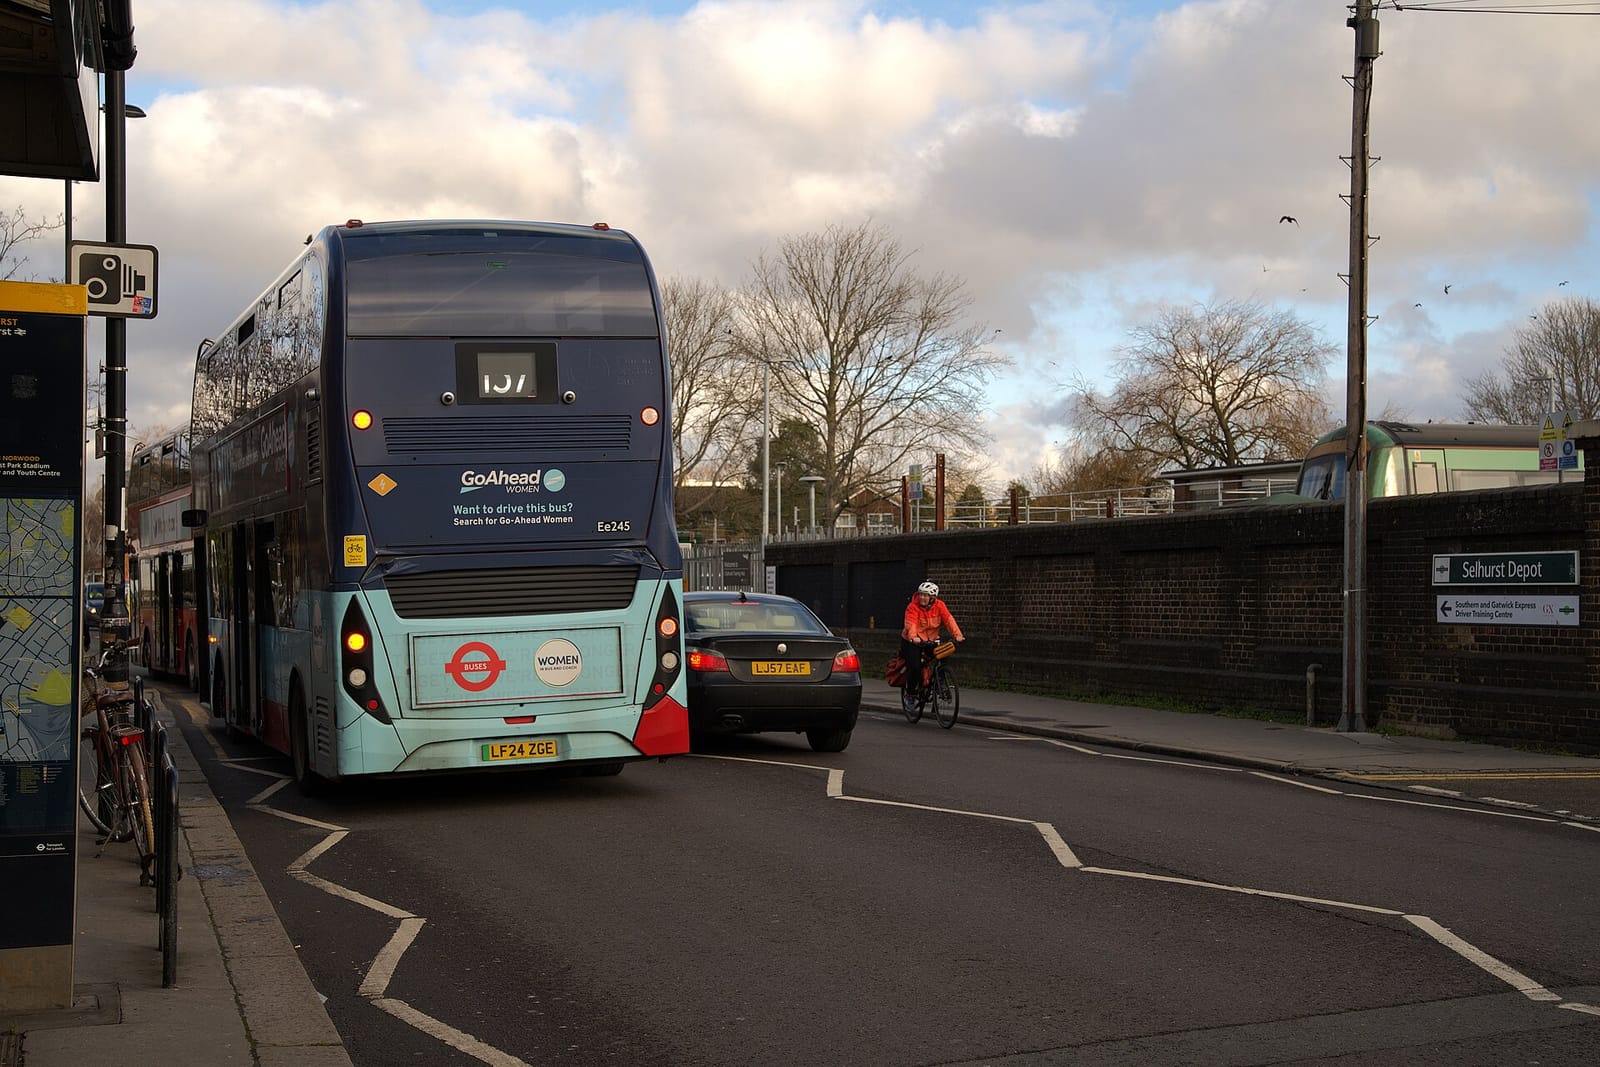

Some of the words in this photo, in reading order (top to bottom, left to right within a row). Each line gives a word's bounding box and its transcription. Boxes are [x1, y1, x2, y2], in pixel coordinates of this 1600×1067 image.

[460, 469, 541, 486] GoAhead
[506, 485, 540, 494] WOMEN
[453, 504, 479, 515] Want
[483, 504, 494, 514] to
[496, 503, 523, 514] drive
[526, 503, 546, 513] this
[549, 502, 573, 513] bus?
[453, 517, 483, 526] Search
[485, 516, 497, 525] for
[499, 516, 541, 525] Go-Ahead
[543, 515, 574, 524] Women
[597, 521, 631, 532] Ee245
[1462, 559, 1506, 578] Selhurst
[1508, 560, 1543, 582] Depot
[1455, 601, 1479, 609] Southern
[1480, 601, 1490, 609] and
[1491, 601, 1514, 609] Gatwick
[1515, 601, 1537, 610] Express
[1455, 610, 1471, 618] Driver
[1472, 610, 1494, 620] Training
[1494, 610, 1513, 618] Centre
[537, 655, 579, 666] WOMEN
[464, 663, 488, 671] BUSES
[756, 663, 783, 673] LJ57
[785, 663, 805, 673] EAF
[491, 743, 525, 758] LF24
[529, 742, 554, 755] ZGE
